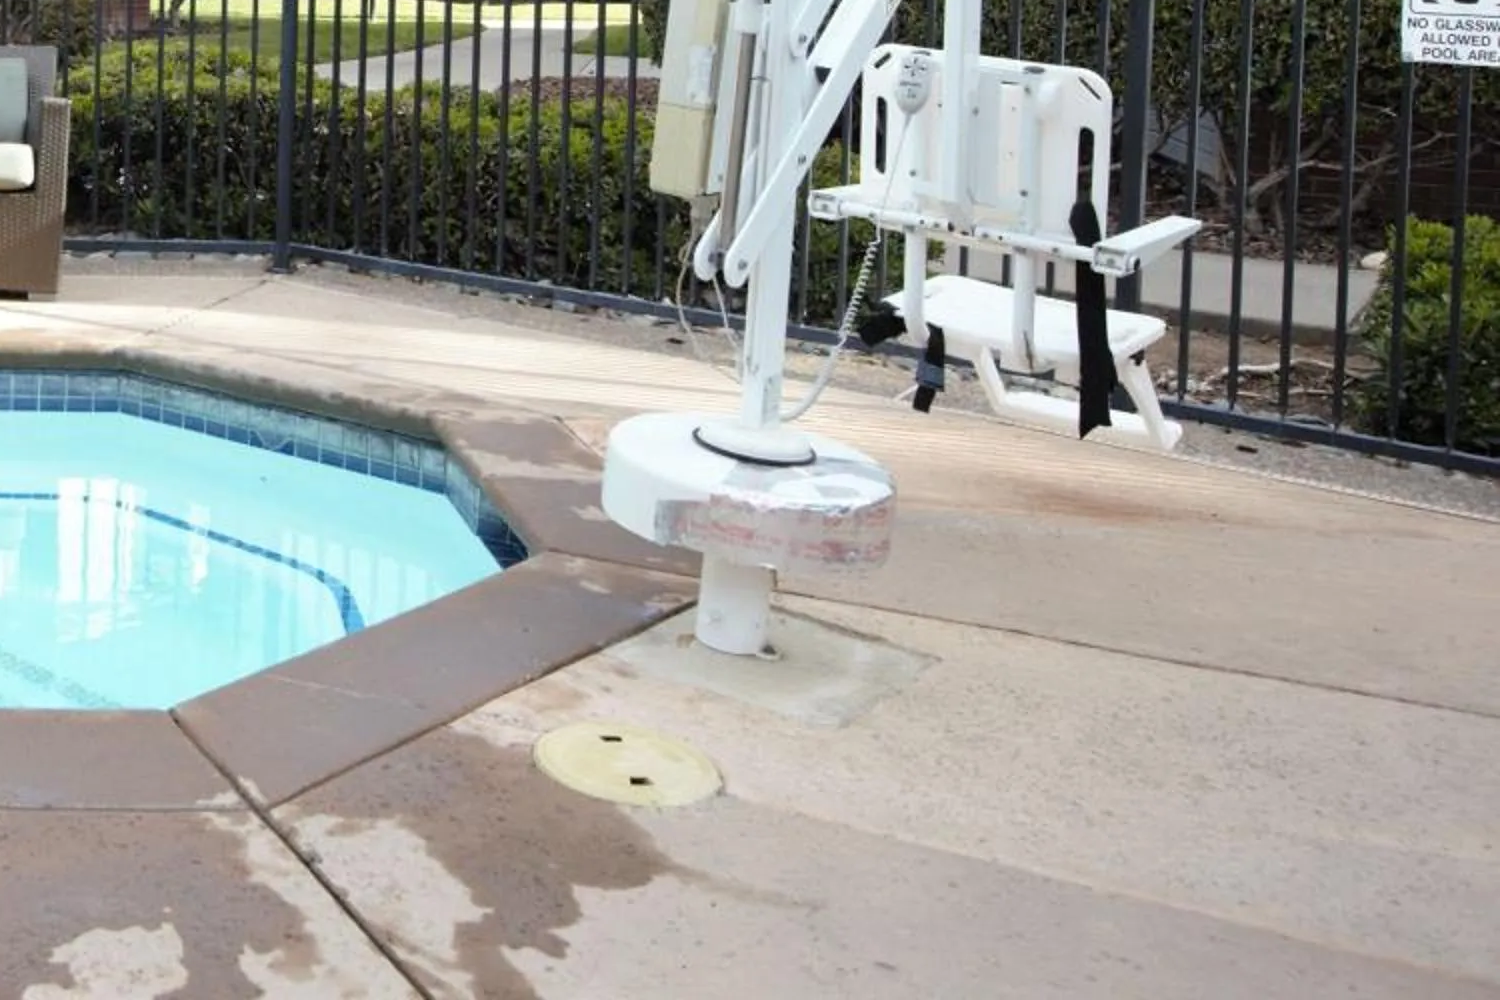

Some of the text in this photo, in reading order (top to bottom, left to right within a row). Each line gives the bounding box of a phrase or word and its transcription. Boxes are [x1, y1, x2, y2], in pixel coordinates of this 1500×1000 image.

[1407, 17, 1429, 30] NO
[1420, 33, 1491, 47] ALLOWED
[1421, 47, 1500, 63] POOL ARE
